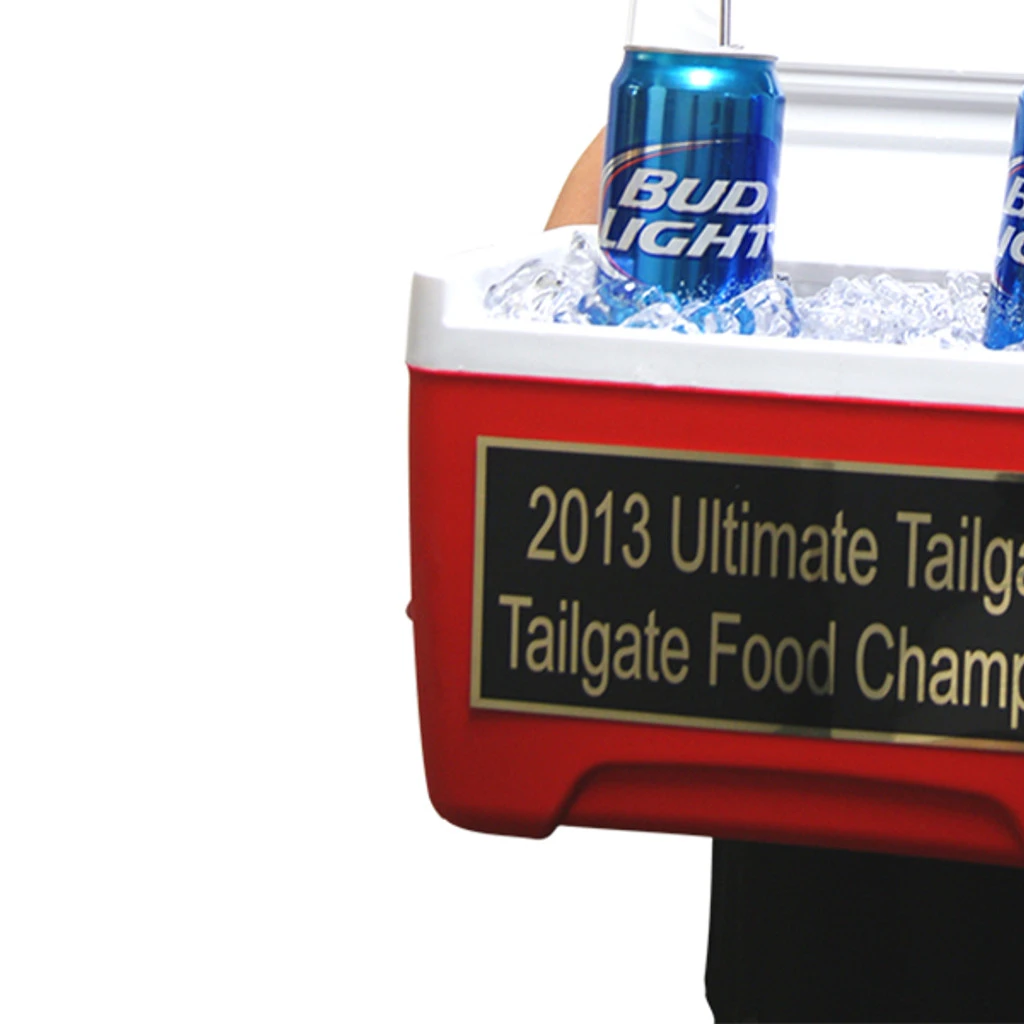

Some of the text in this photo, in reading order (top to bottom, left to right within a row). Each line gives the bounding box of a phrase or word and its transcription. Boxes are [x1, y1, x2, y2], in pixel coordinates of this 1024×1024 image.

[619, 167, 768, 216] BUD
[599, 207, 776, 259] LIGHT
[526, 485, 652, 569] 2013
[670, 495, 879, 586] Ultimate
[499, 594, 690, 697] Tailgate
[708, 611, 837, 696] Food
